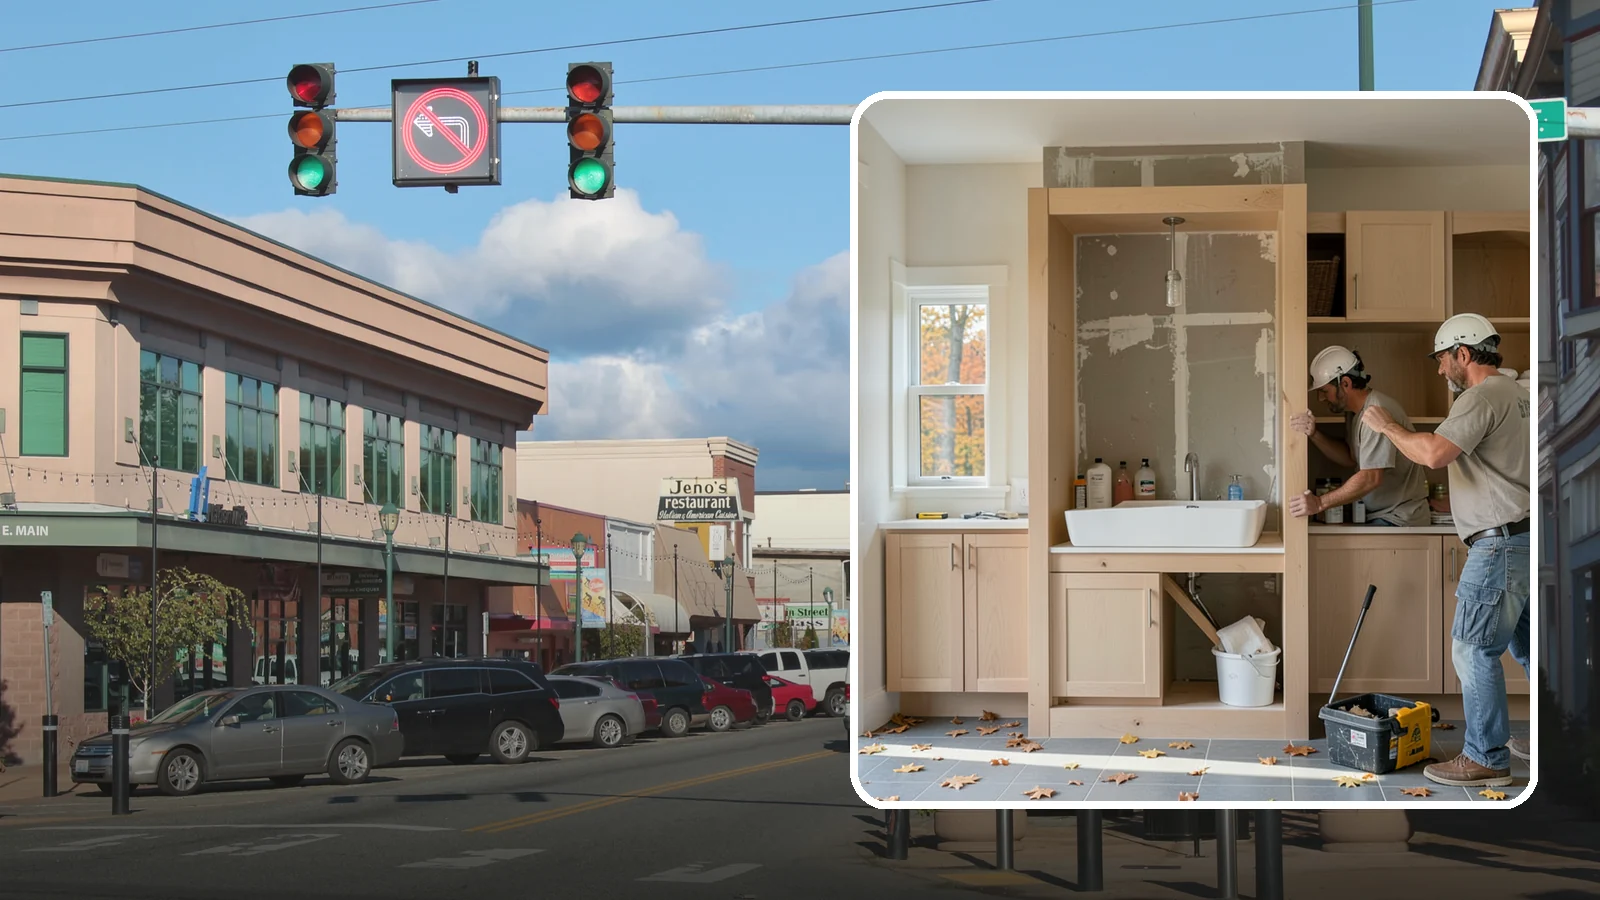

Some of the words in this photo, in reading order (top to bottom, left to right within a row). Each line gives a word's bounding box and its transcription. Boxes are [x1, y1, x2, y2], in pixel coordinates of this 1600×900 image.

[669, 480, 727, 495] Jeno's
[664, 496, 731, 509] restaurant
[659, 509, 681, 519] Italian
[686, 509, 715, 519] American
[715, 509, 738, 519] Cuisine
[2, 525, 13, 536] E.
[15, 525, 49, 536] MAIN
[797, 607, 829, 617] Street
